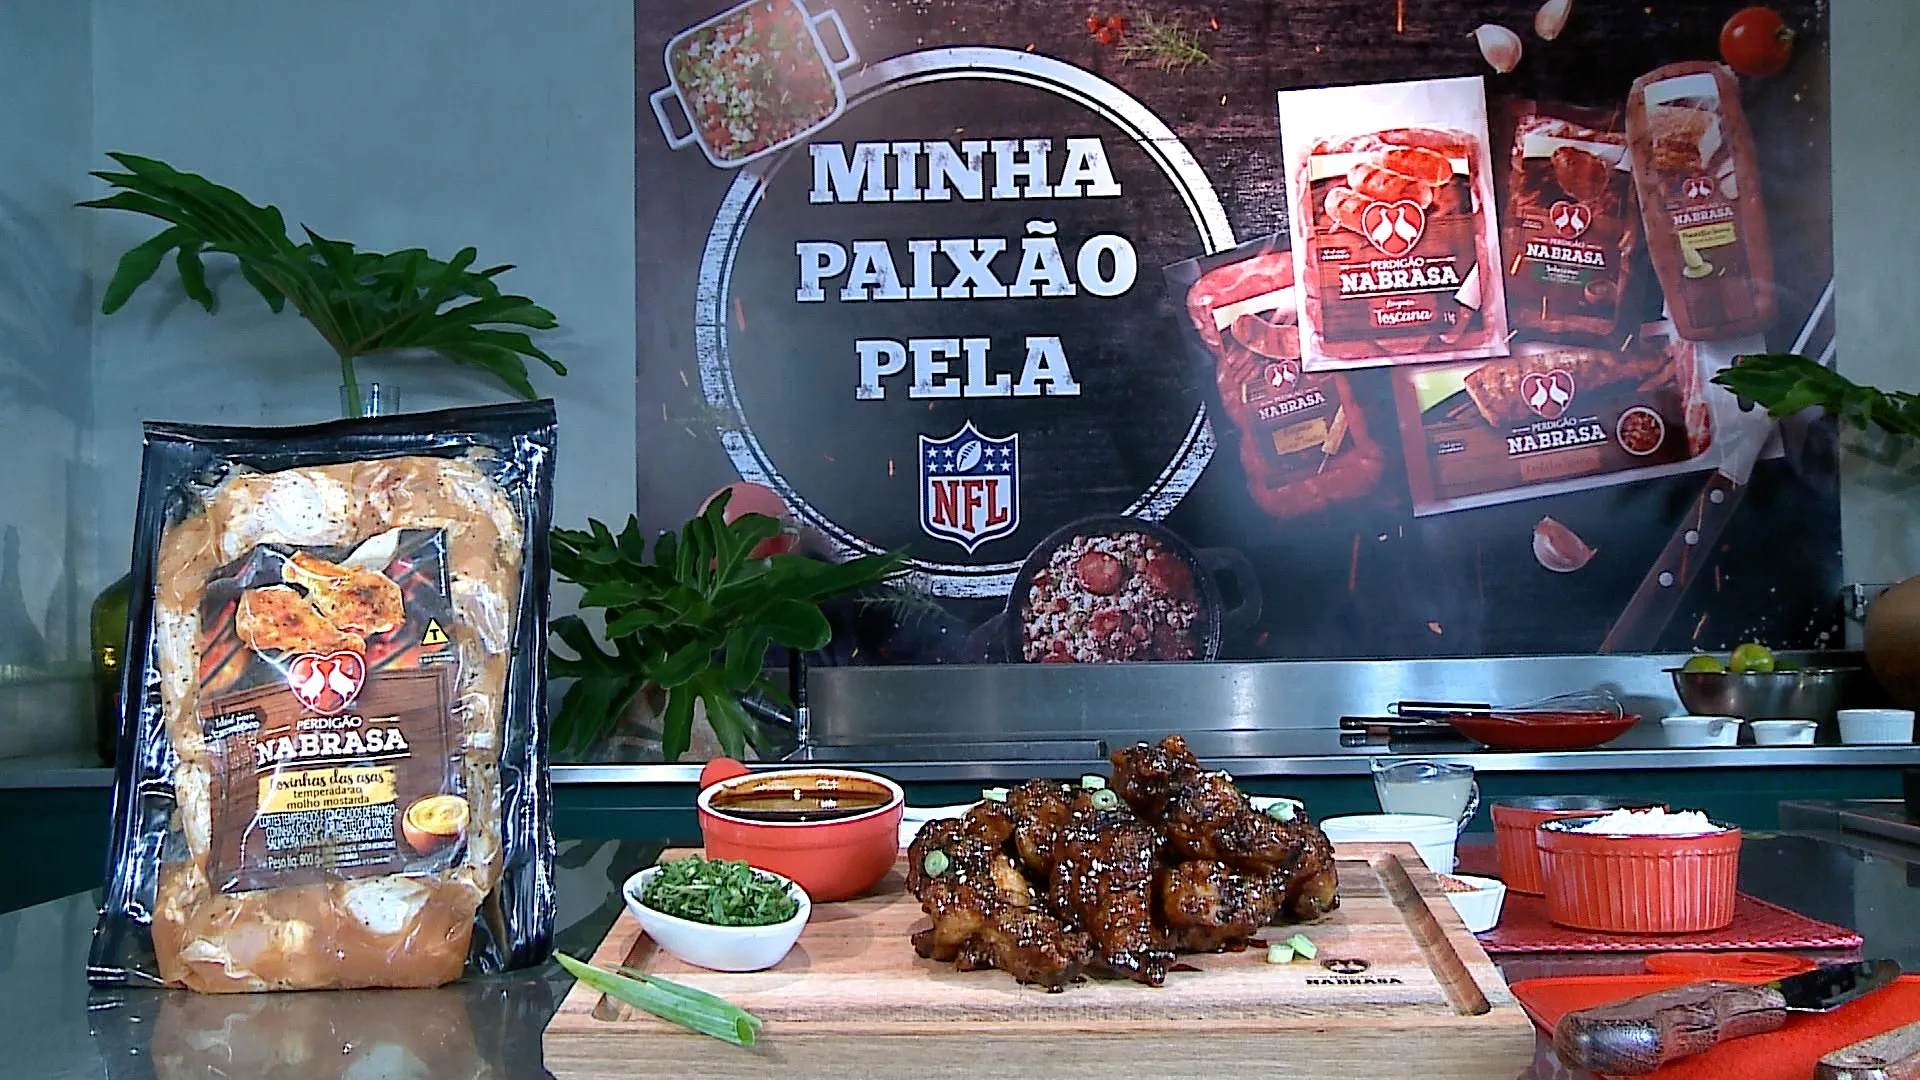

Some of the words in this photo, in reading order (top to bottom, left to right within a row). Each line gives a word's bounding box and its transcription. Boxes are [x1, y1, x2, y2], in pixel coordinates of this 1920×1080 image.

[808, 137, 1123, 203] MINHA
[796, 220, 1138, 302] PAIXÃO
[1371, 256, 1425, 270] PERDIGÃO
[1373, 309, 1433, 325] Toscana
[856, 335, 1082, 400] PELA
[1531, 416, 1577, 433] PERDIGÃO
[932, 480, 1008, 533] NFL
[429, 628, 440, 641] T
[296, 716, 363, 731] PERDIGÃO
[328, 768, 354, 784] das
[356, 772, 384, 784] asas
[286, 798, 321, 810] molho
[322, 794, 370, 806] mostarda
[268, 856, 286, 869] Peso
[300, 853, 314, 866] 800
